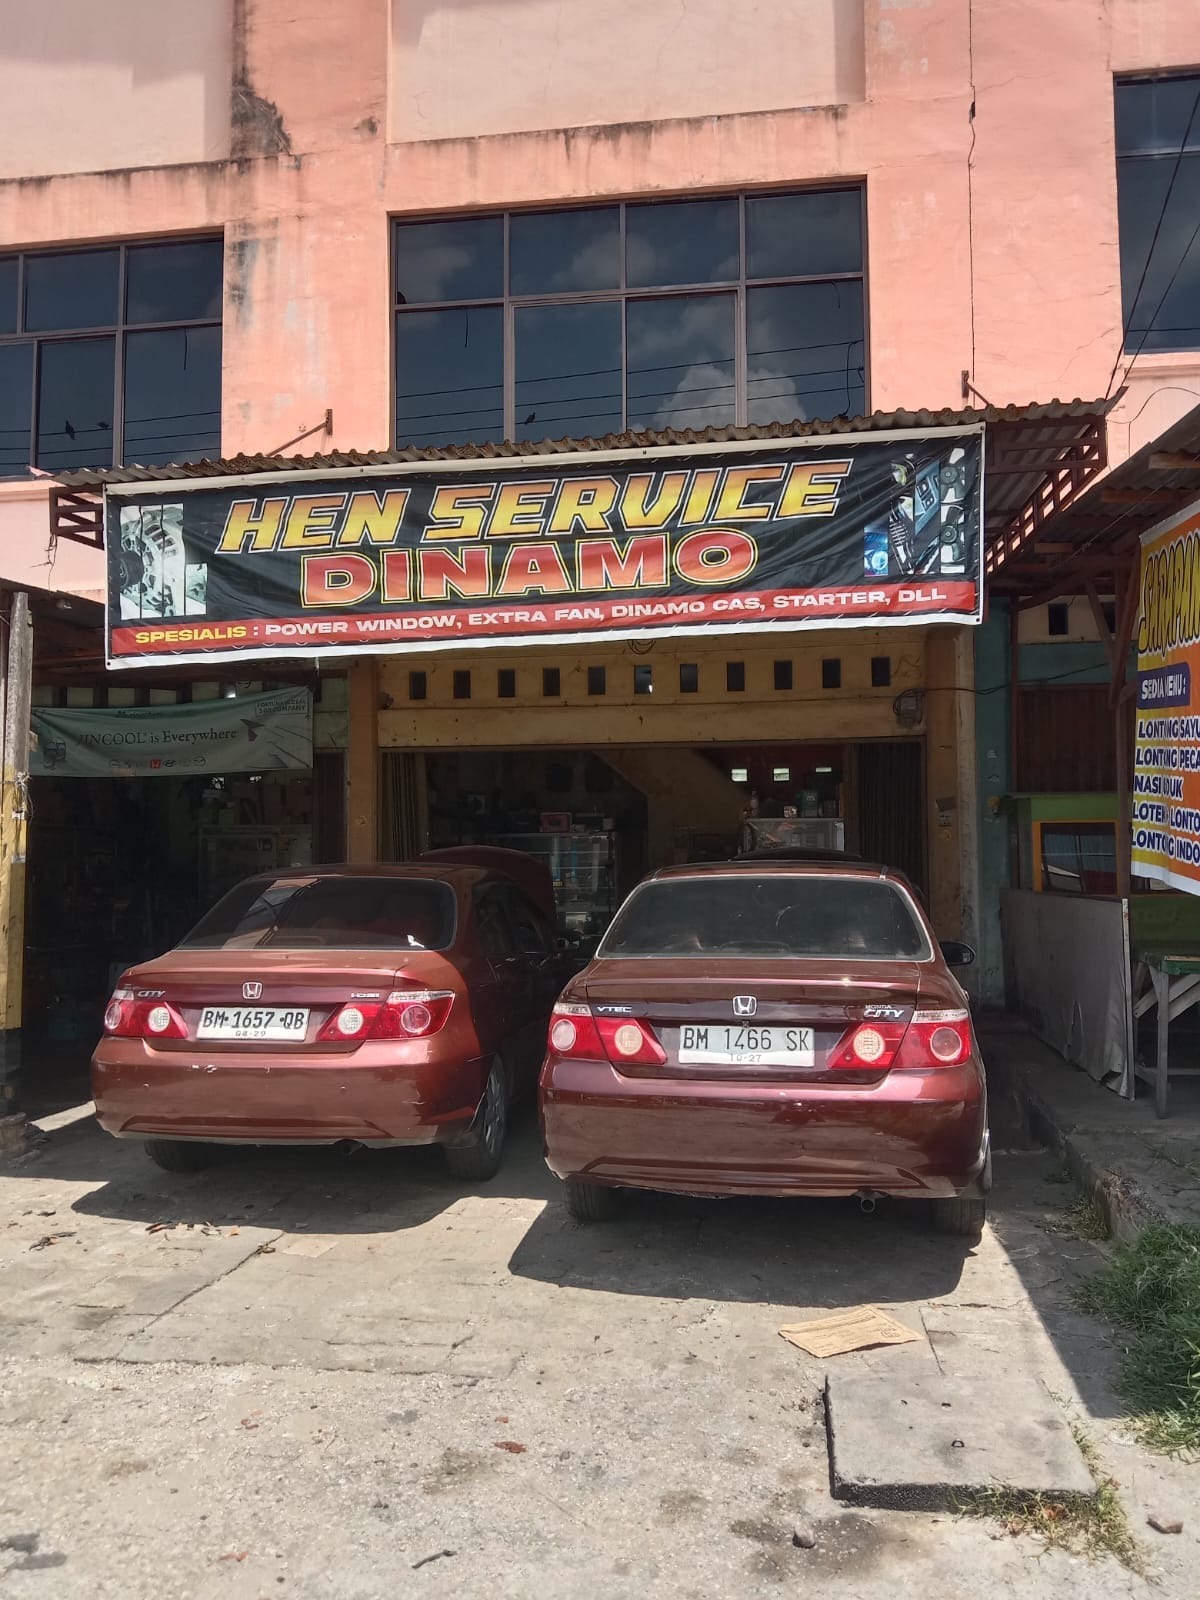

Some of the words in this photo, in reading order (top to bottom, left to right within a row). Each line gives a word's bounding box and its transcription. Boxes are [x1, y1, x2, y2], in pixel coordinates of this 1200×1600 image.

[215, 488, 412, 555] HEN
[419, 458, 855, 544] SERVICE
[299, 527, 758, 609] DINAMO
[135, 625, 247, 644] SPESIALIS
[265, 621, 349, 636] POWER
[356, 614, 462, 632] WINDOW,
[468, 610, 547, 626] EXTRA
[554, 607, 605, 622] FAN,
[611, 601, 705, 618] DINAMO
[712, 597, 766, 612] CAS,
[773, 591, 891, 609] STARTER,
[898, 588, 947, 602] DLL
[150, 732, 160, 744] is
[162, 727, 237, 745] Everywhere
[1134, 775, 1161, 794] NASI
[1132, 802, 1168, 824] LOTE
[1131, 828, 1175, 856] LONTOG
[137, 990, 166, 998] CITY
[202, 1010, 226, 1028] BM
[231, 1011, 275, 1029] 1657
[283, 1012, 305, 1030] QB
[863, 1008, 905, 1018] CITY
[683, 1028, 709, 1050] BM
[724, 1028, 772, 1050] 1466
[786, 1030, 809, 1051] SK
